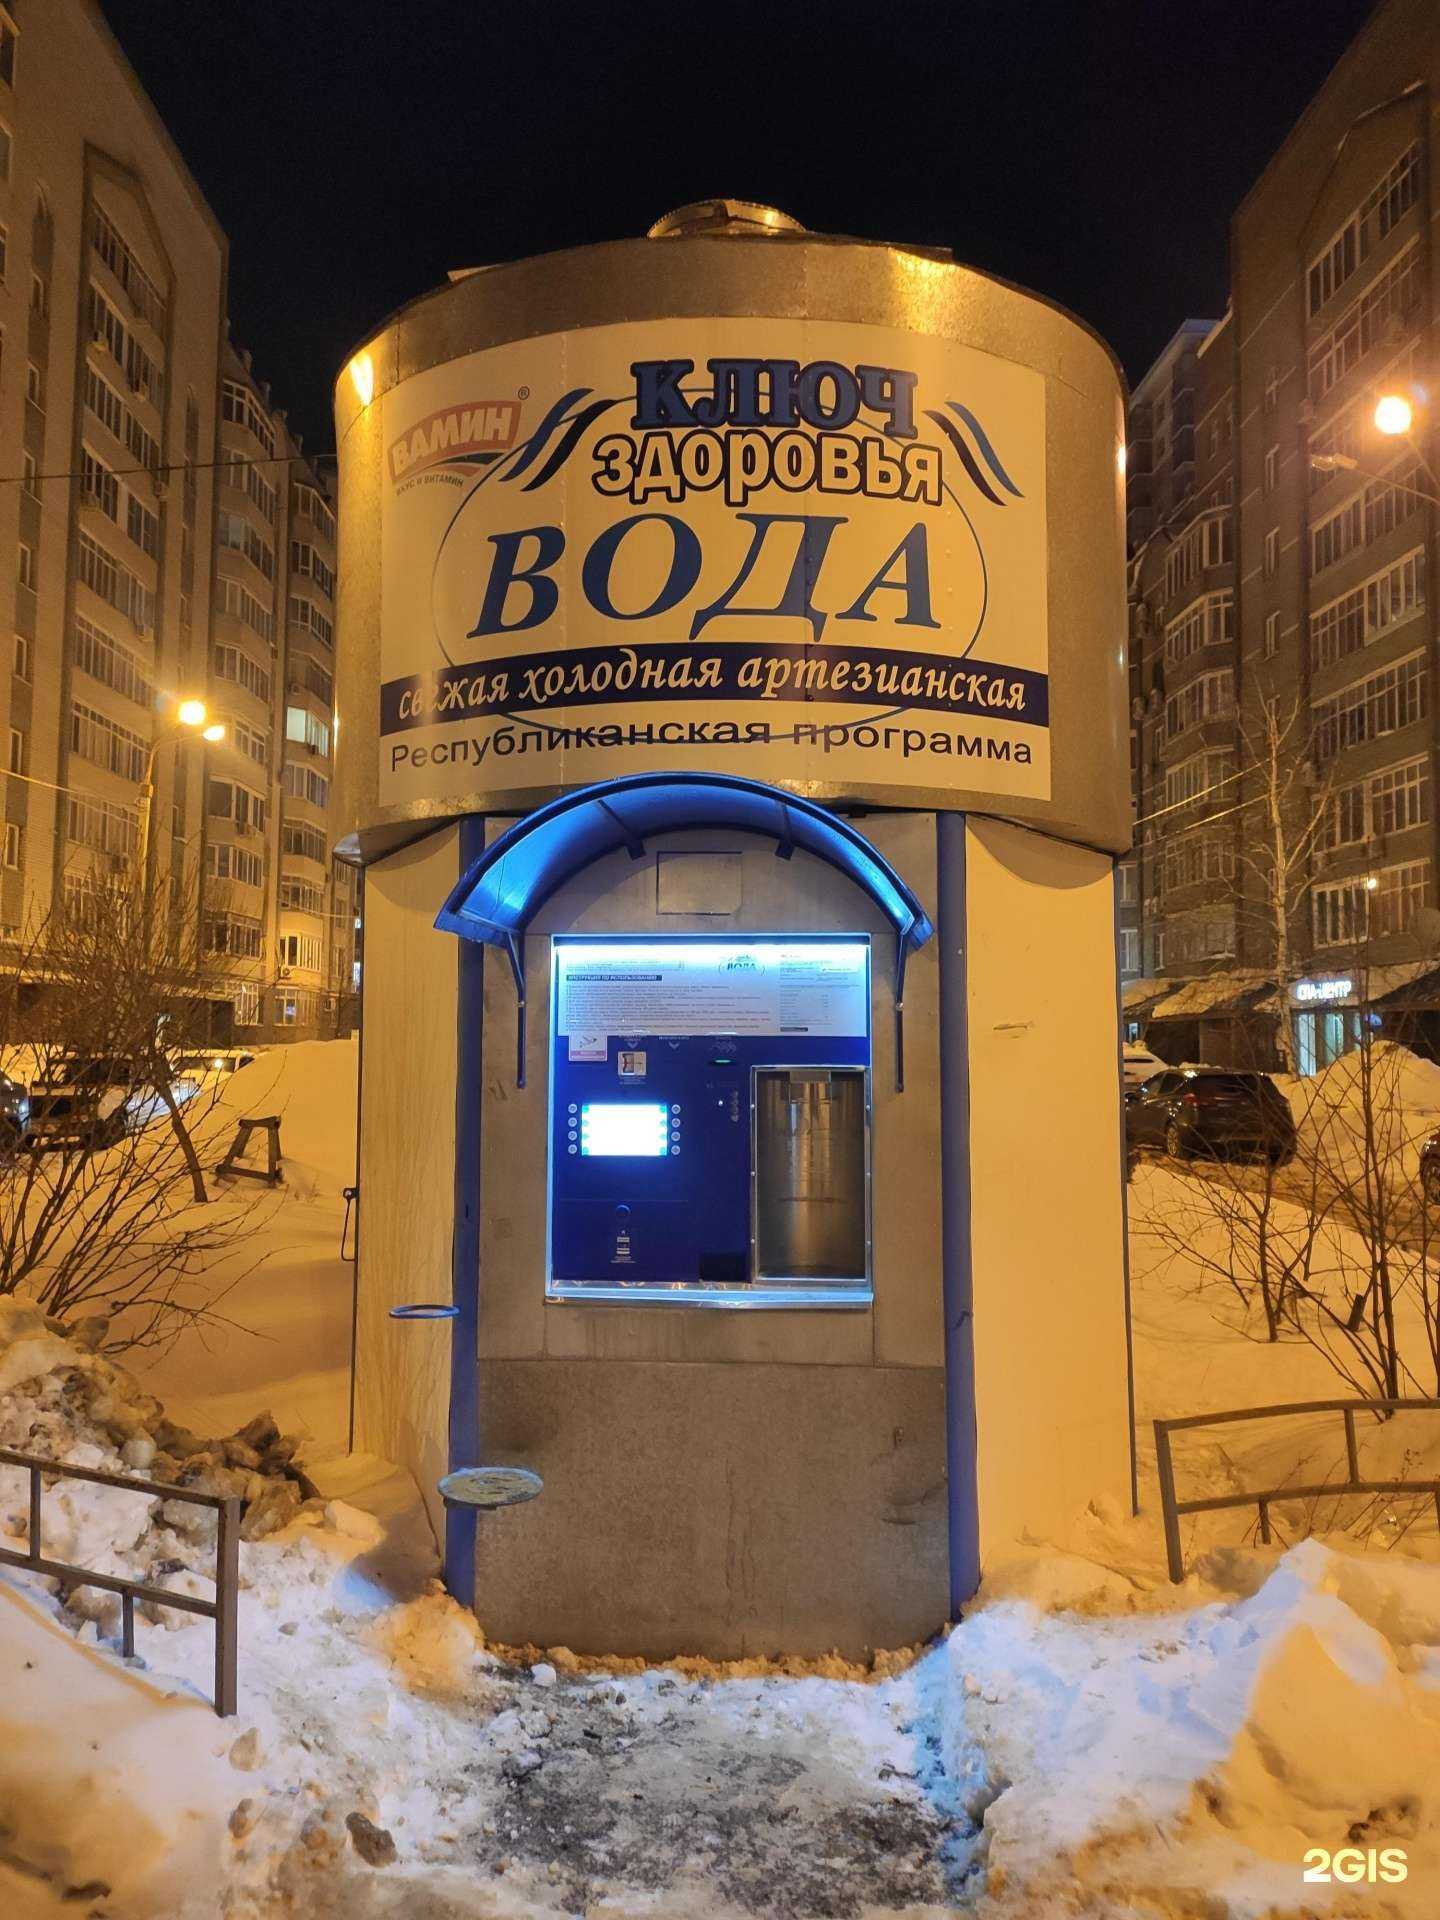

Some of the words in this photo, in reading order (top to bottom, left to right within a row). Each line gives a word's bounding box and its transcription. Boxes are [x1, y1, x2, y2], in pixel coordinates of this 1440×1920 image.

[630, 359, 918, 439] КЛЮЧ
[391, 406, 513, 476] ВАМИН
[467, 512, 942, 642] ВОДА
[518, 648, 723, 704] холодная
[736, 656, 1027, 711] артезианская
[391, 720, 770, 772] Республиканская
[792, 722, 1032, 765] программа
